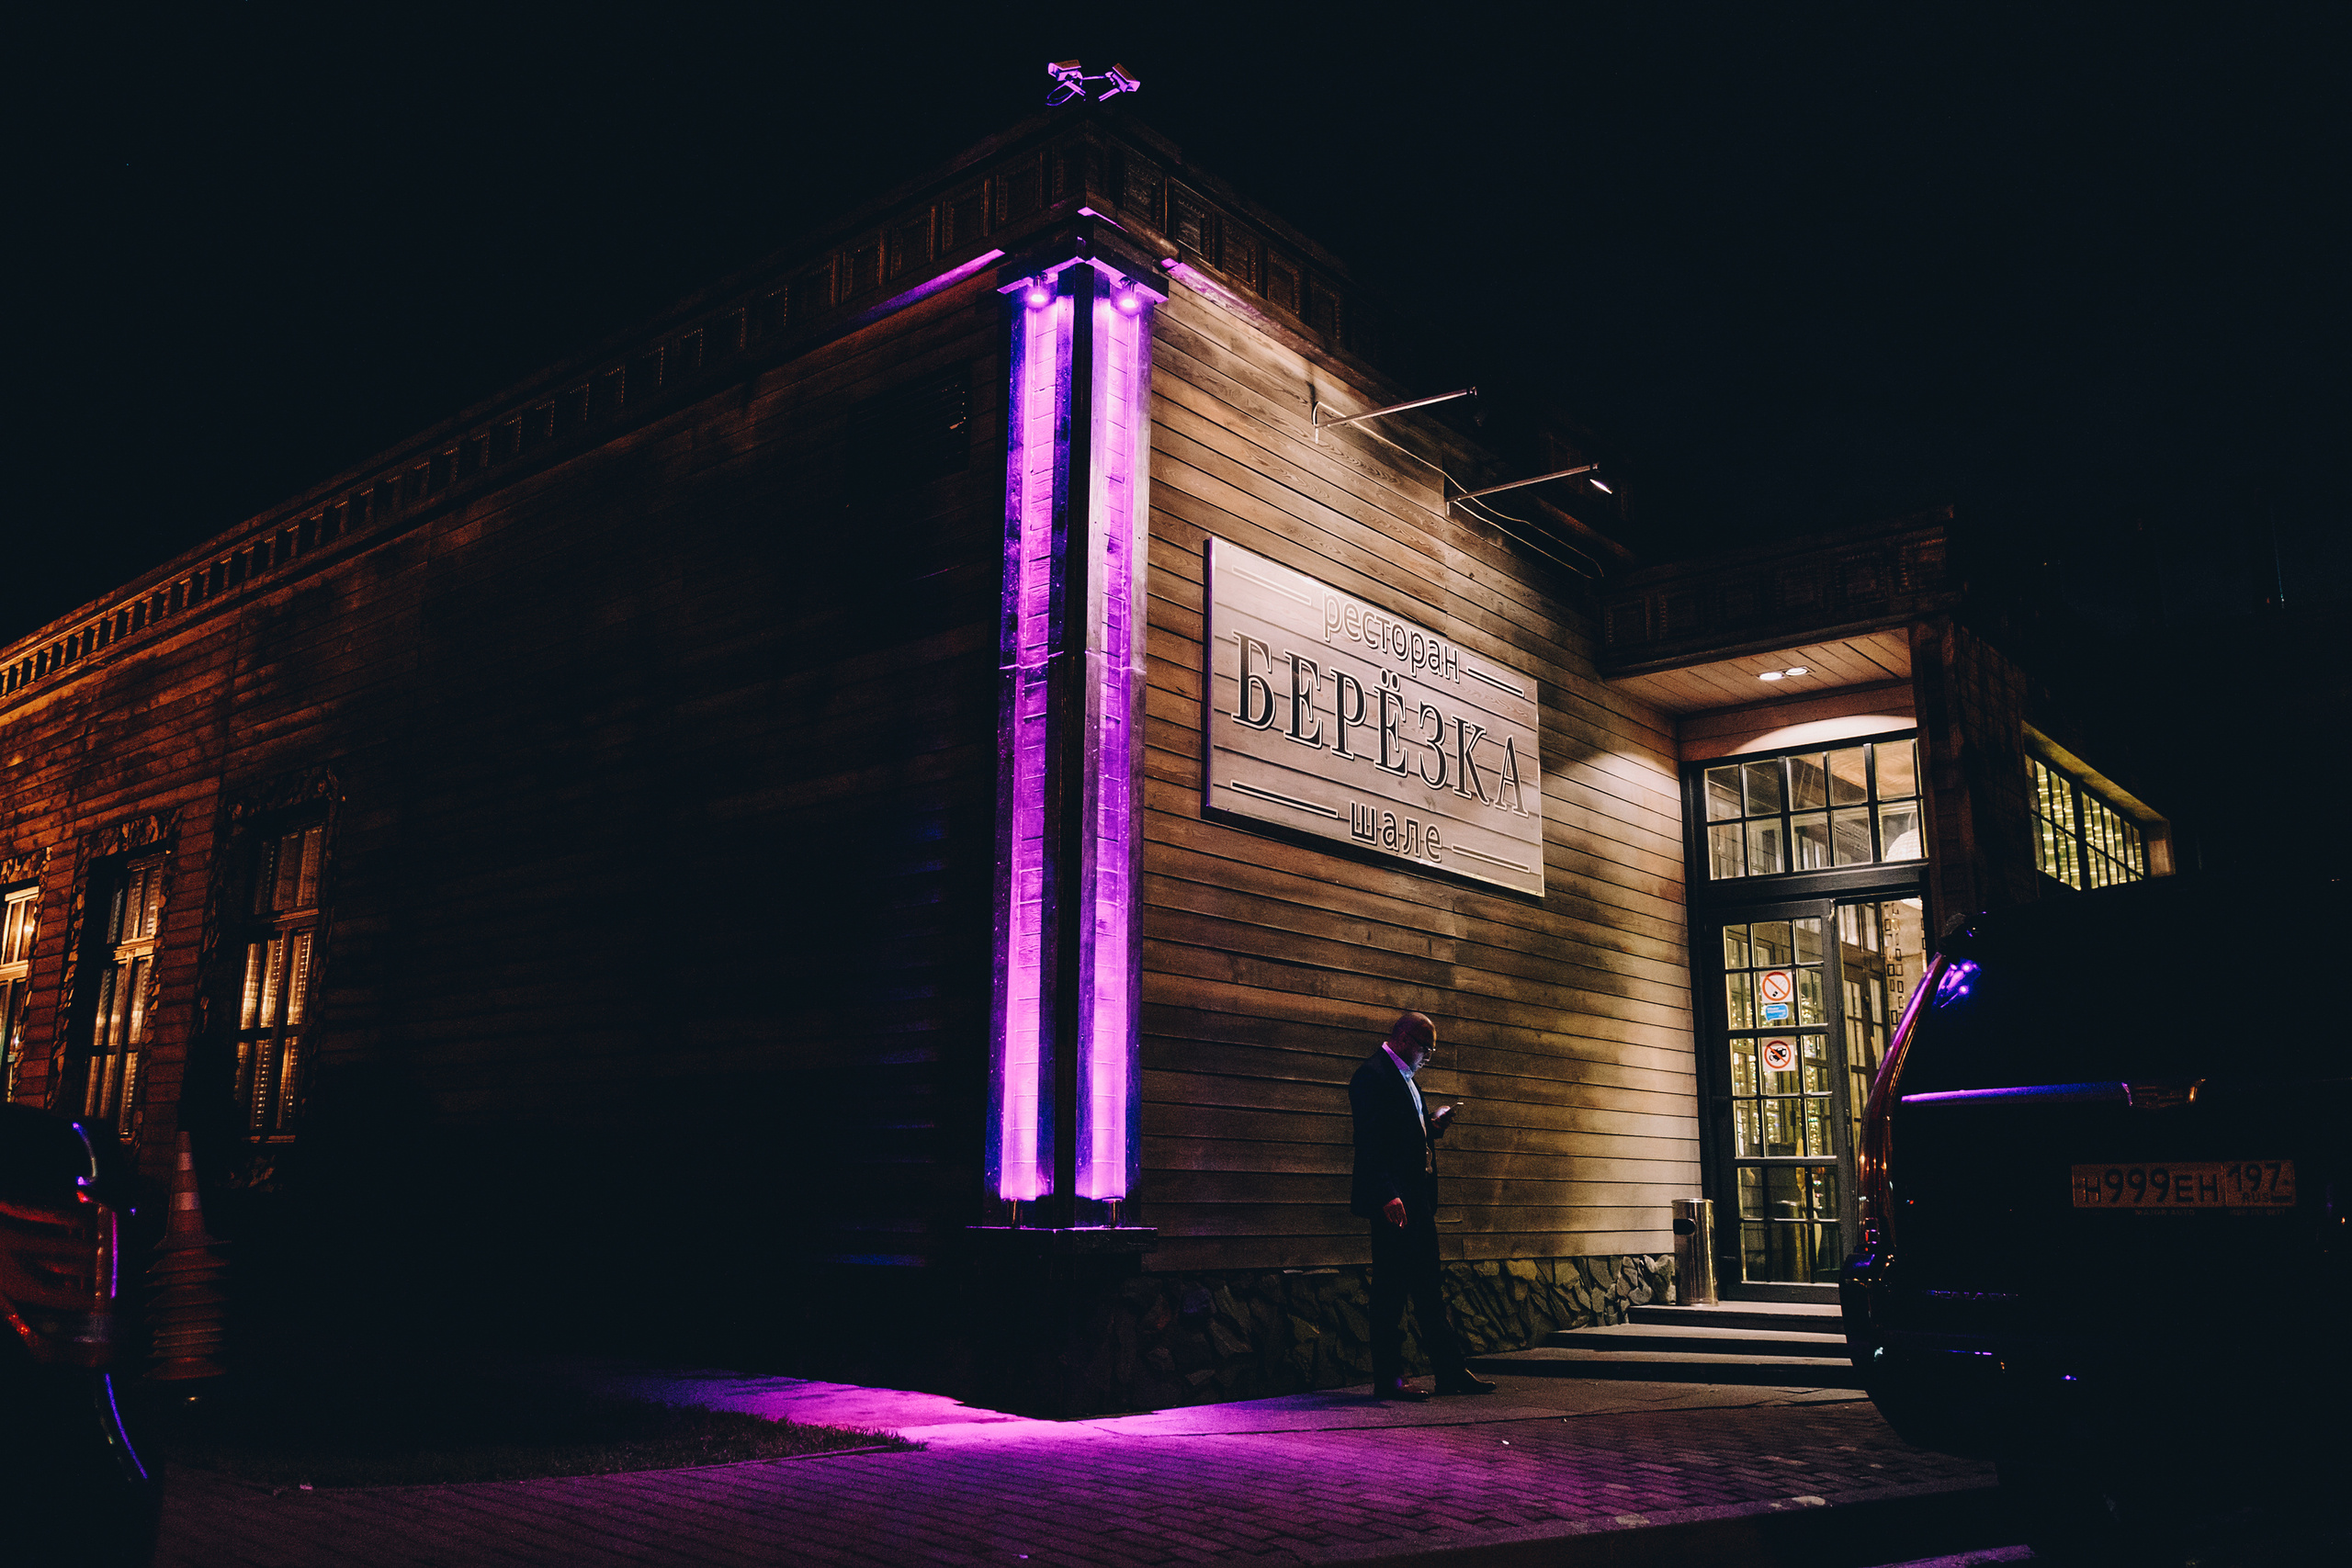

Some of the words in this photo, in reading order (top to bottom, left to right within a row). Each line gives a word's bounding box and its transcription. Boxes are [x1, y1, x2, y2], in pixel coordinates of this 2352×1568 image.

[1323, 592, 1461, 682] ресторан
[1231, 630, 1529, 818] БЕРЁЗКА
[1349, 801, 1443, 863] шале
[2227, 1162, 2281, 1191] 197
[2242, 1191, 2270, 1203] RUS
